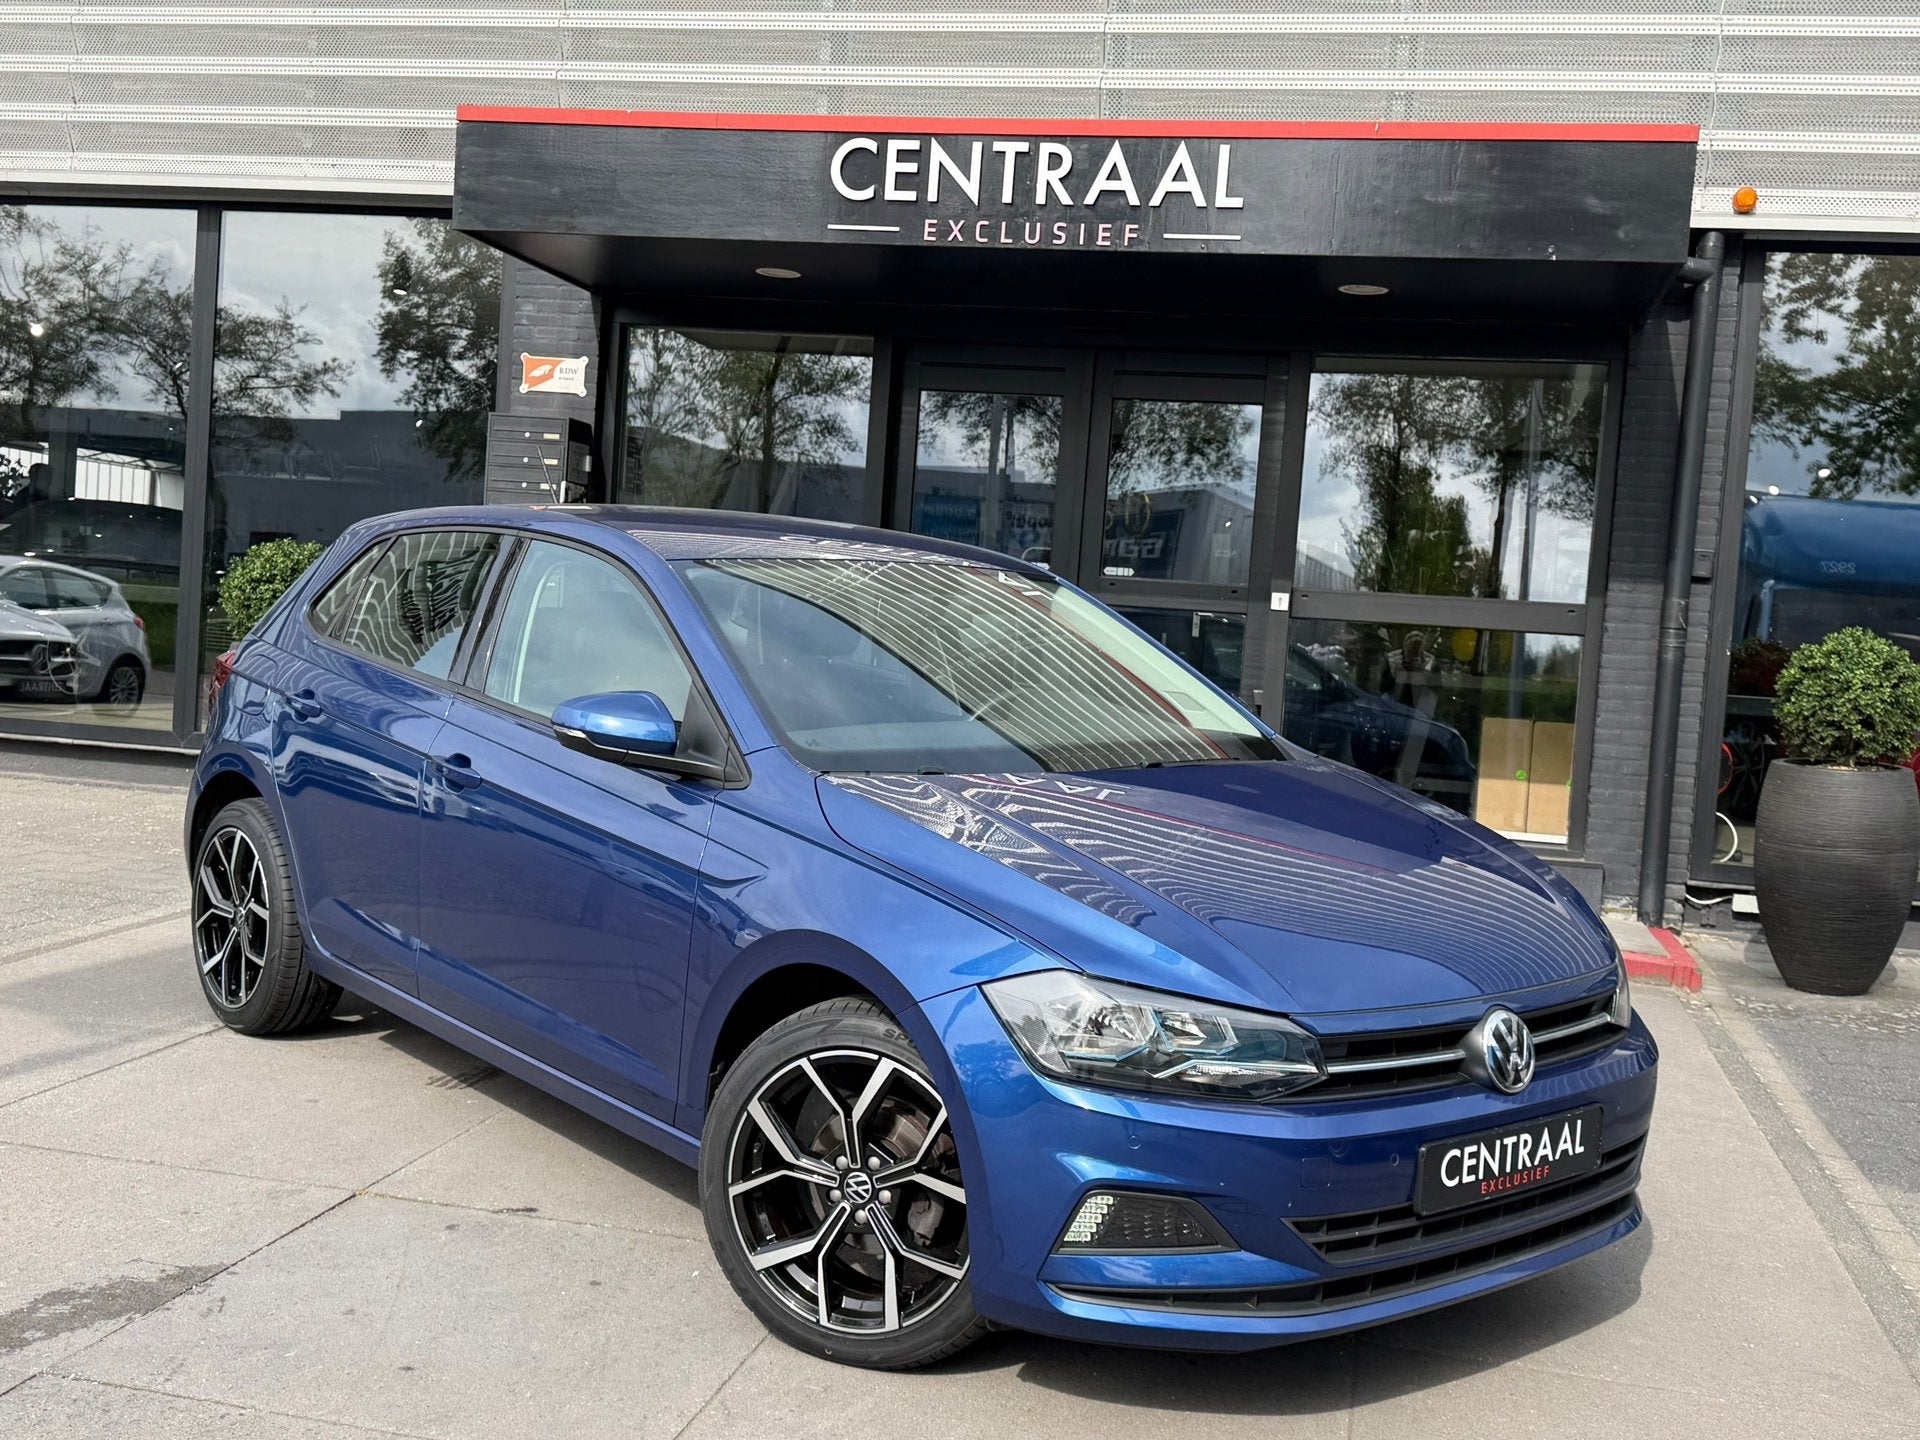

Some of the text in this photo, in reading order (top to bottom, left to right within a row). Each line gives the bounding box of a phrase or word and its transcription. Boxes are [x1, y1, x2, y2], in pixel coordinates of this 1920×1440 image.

[830, 137, 1244, 209] CENTRAAL
[922, 219, 1139, 246] EXCLUSIEF
[559, 367, 578, 375] RDW
[1440, 1119, 1585, 1188] CENTRAAL
[1481, 1165, 1550, 1195] EXCLUSIEF
